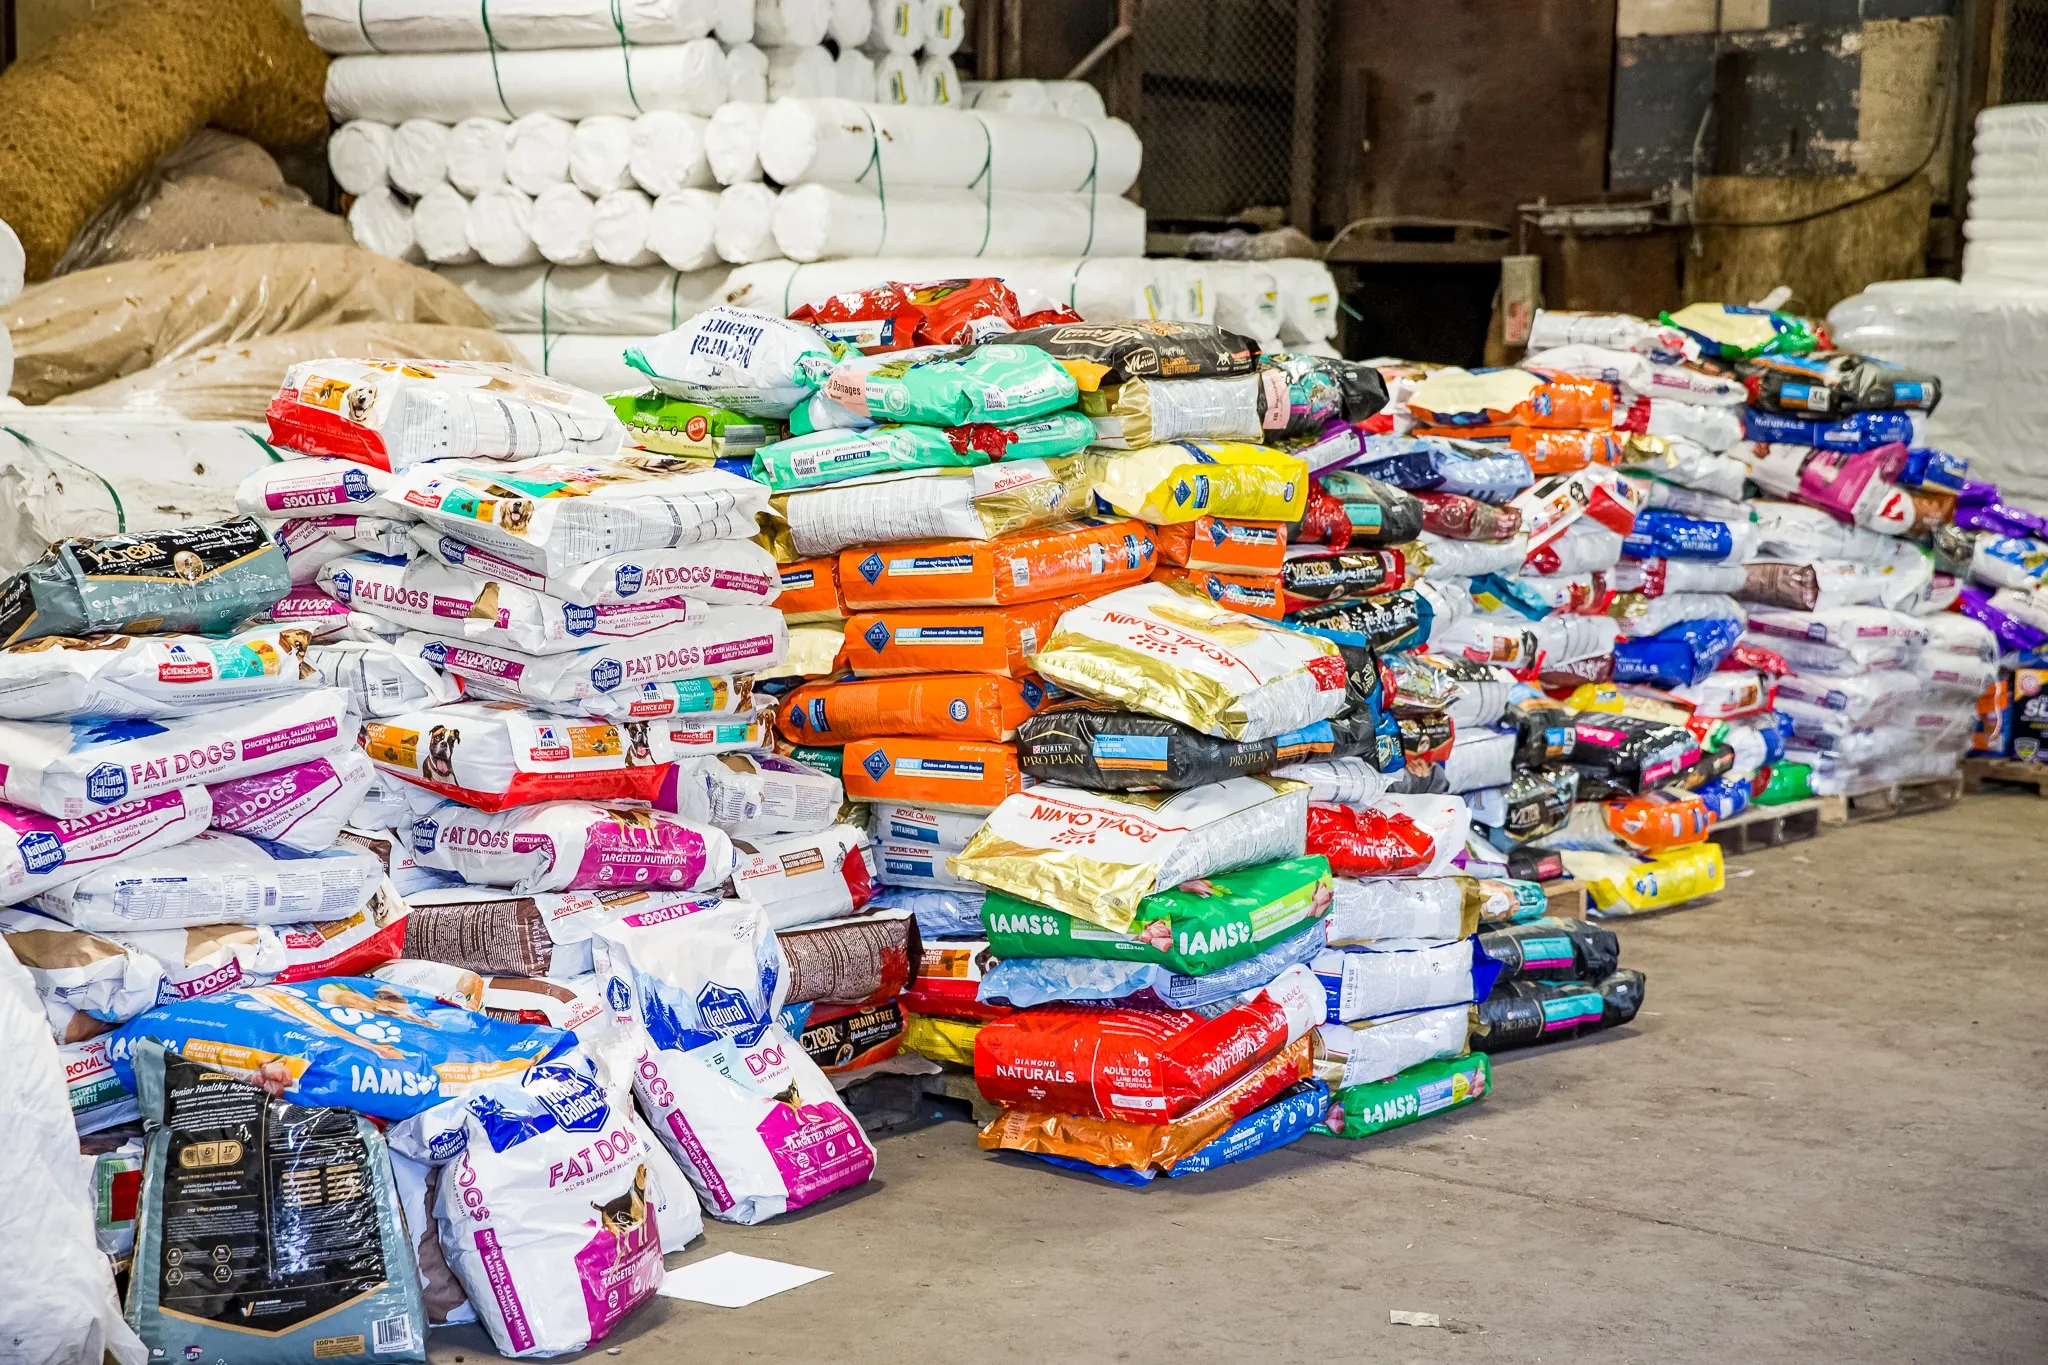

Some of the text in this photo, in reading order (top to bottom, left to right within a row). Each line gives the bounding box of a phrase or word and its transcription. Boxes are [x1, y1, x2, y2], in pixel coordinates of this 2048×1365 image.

[832, 379, 861, 396] Damages
[835, 451, 869, 462] GRAIN FREE
[283, 491, 337, 508] FAT DOGS
[173, 535, 198, 546] Senior
[644, 566, 712, 587] FAT DOGS
[277, 598, 335, 611] FAT DOGS
[354, 579, 429, 609] FAT DOGS
[568, 617, 594, 630] Balance
[898, 629, 918, 637] ADULT
[1103, 610, 1236, 668] ROYAL CANIN
[625, 647, 700, 677] FAT DOGS
[633, 703, 672, 713] SCIENCE DIET
[243, 721, 332, 750] CHICKEN MEAL, SALMON MEAL
[367, 724, 388, 734] LIGHT
[266, 733, 318, 752] BARLEY FORMULA
[1041, 744, 1069, 753] PURINA
[131, 741, 236, 785] FAT DOGS
[1022, 754, 1084, 768] PRO PLAN
[91, 773, 124, 789] Natural
[161, 764, 227, 787] SUPPORT WEIGHT
[90, 784, 125, 798] Balance
[212, 806, 238, 827] FAT
[241, 777, 297, 817] DOGS
[263, 813, 294, 832] FORMULA
[1029, 803, 1093, 825] CANIN
[90, 829, 142, 852] BARLEY FORMULA
[440, 826, 510, 849] FAT DOGS
[1098, 817, 1158, 844] ROYAL
[22, 834, 58, 857] Natural
[27, 848, 63, 870] Balance
[601, 853, 688, 865] TARGETED NUTRITION
[553, 900, 594, 917] ROYAL CANIN
[669, 904, 691, 920] FAT
[989, 912, 1041, 936] IAMS
[1179, 923, 1241, 956] IAMS
[194, 963, 237, 993] DOGS
[702, 1001, 745, 1026] Natural
[848, 1008, 895, 1031] GRAIN FREE
[800, 1024, 841, 1052] CTOR
[187, 1042, 253, 1060] HEALTHY WEIGHT
[66, 1056, 103, 1076] ROYAL
[1014, 1057, 1057, 1068] DIAMOND
[1102, 1066, 1151, 1077] ADULT DOG
[98, 1077, 121, 1092] SUPPO
[351, 1064, 421, 1097] IAMS
[995, 1065, 1077, 1083] NATURALS
[170, 1082, 228, 1099] Senior Healthy
[1363, 1096, 1407, 1124] IAMS
[431, 1130, 463, 1153] Natural
[1222, 1133, 1264, 1156] SALMON SWEET
[549, 1150, 595, 1187] FAT
[564, 1165, 617, 1193] HELPS SUPPORT
[701, 1157, 719, 1185] SALMON
[715, 1181, 730, 1203] MEAL
[601, 1262, 636, 1289] TARGETED
[484, 1254, 513, 1323] BARLEY FORMULA
[494, 1260, 507, 1285] MEAL,
[503, 1284, 520, 1318] SALMON
[515, 1318, 529, 1341] MEAL
[186, 1352, 199, 1360] USA
